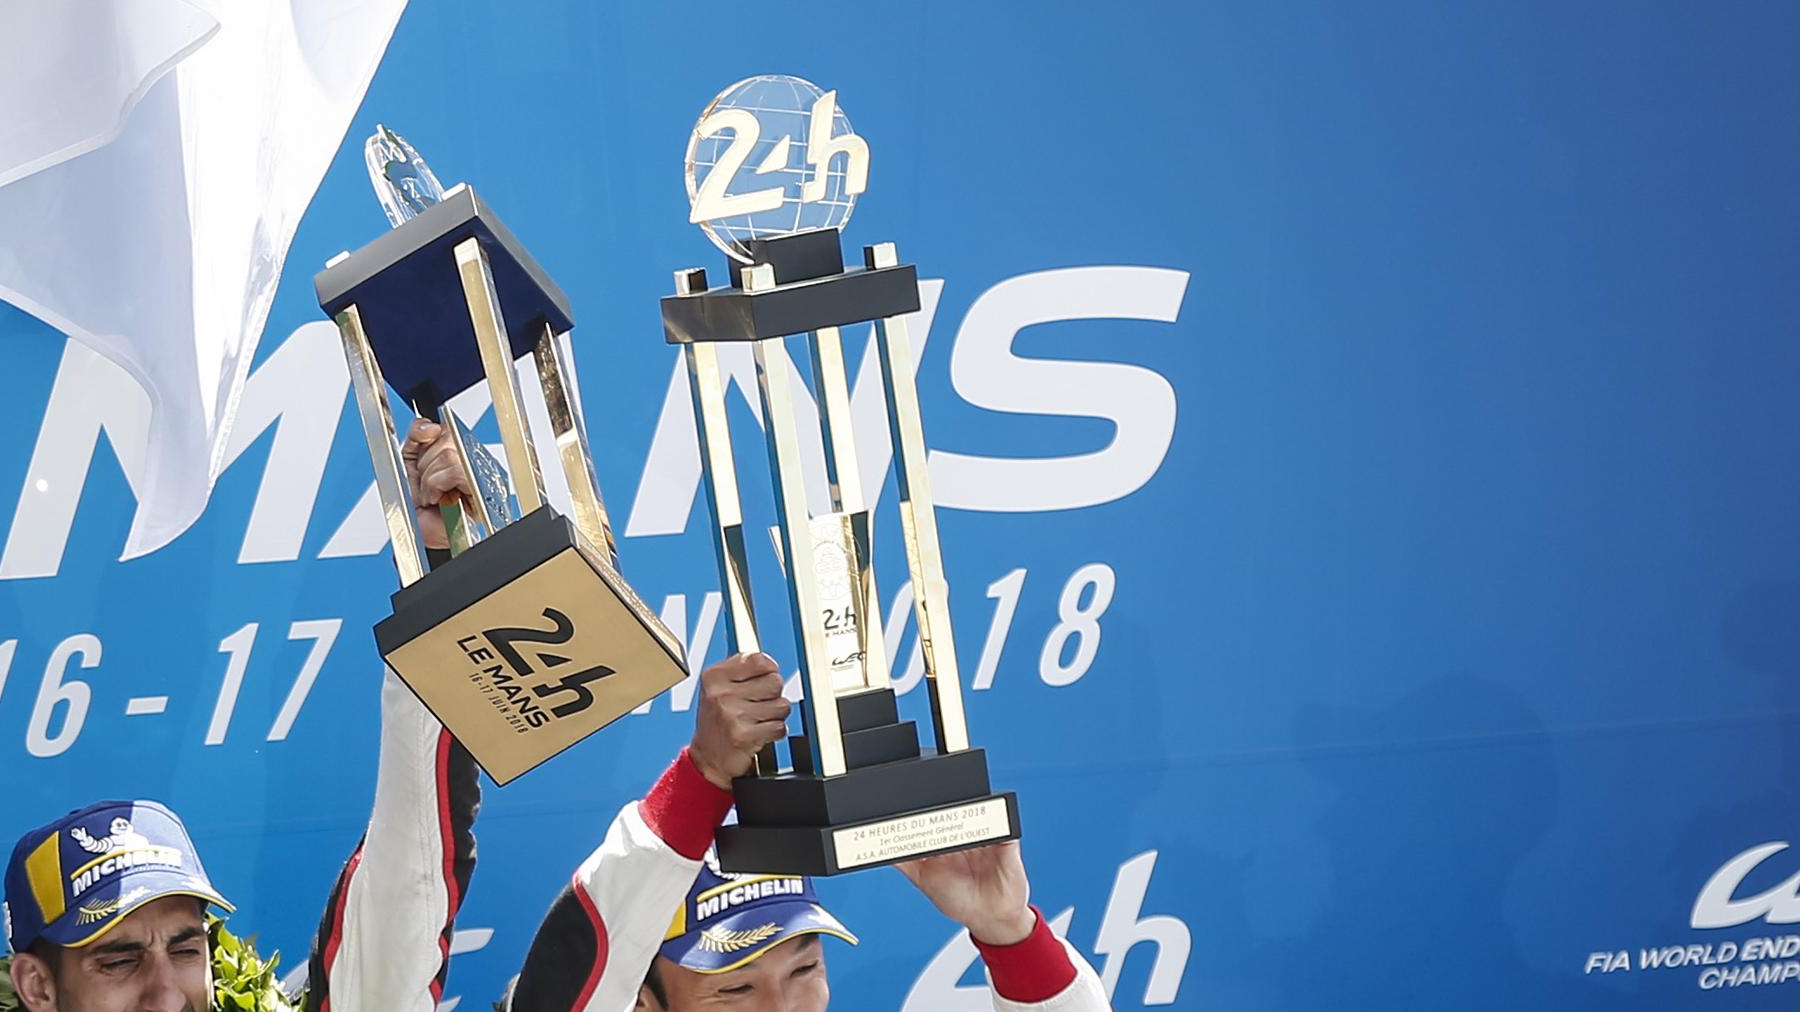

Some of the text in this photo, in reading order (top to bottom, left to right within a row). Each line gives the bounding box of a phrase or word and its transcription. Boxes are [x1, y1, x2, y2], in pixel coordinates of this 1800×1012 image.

[689, 89, 871, 223] 24h
[780, 563, 1116, 702] 018
[822, 606, 857, 630] 24h
[457, 635, 550, 728] LE MANS
[482, 607, 617, 719] 24h
[488, 695, 511, 714] JUIN
[505, 713, 529, 734] 2018
[853, 806, 986, 841] 24 HEURES DU MANS 2018
[879, 840, 928, 857] AUTOMOBILE
[928, 836, 948, 848] CLUB
[950, 833, 960, 843] DE
[71, 850, 182, 897] MICHELIN
[696, 878, 803, 921] MICHELIN
[1584, 950, 1631, 975] FIA
[1638, 941, 1737, 970] WORLD
[1698, 960, 1800, 990] CHAMP
